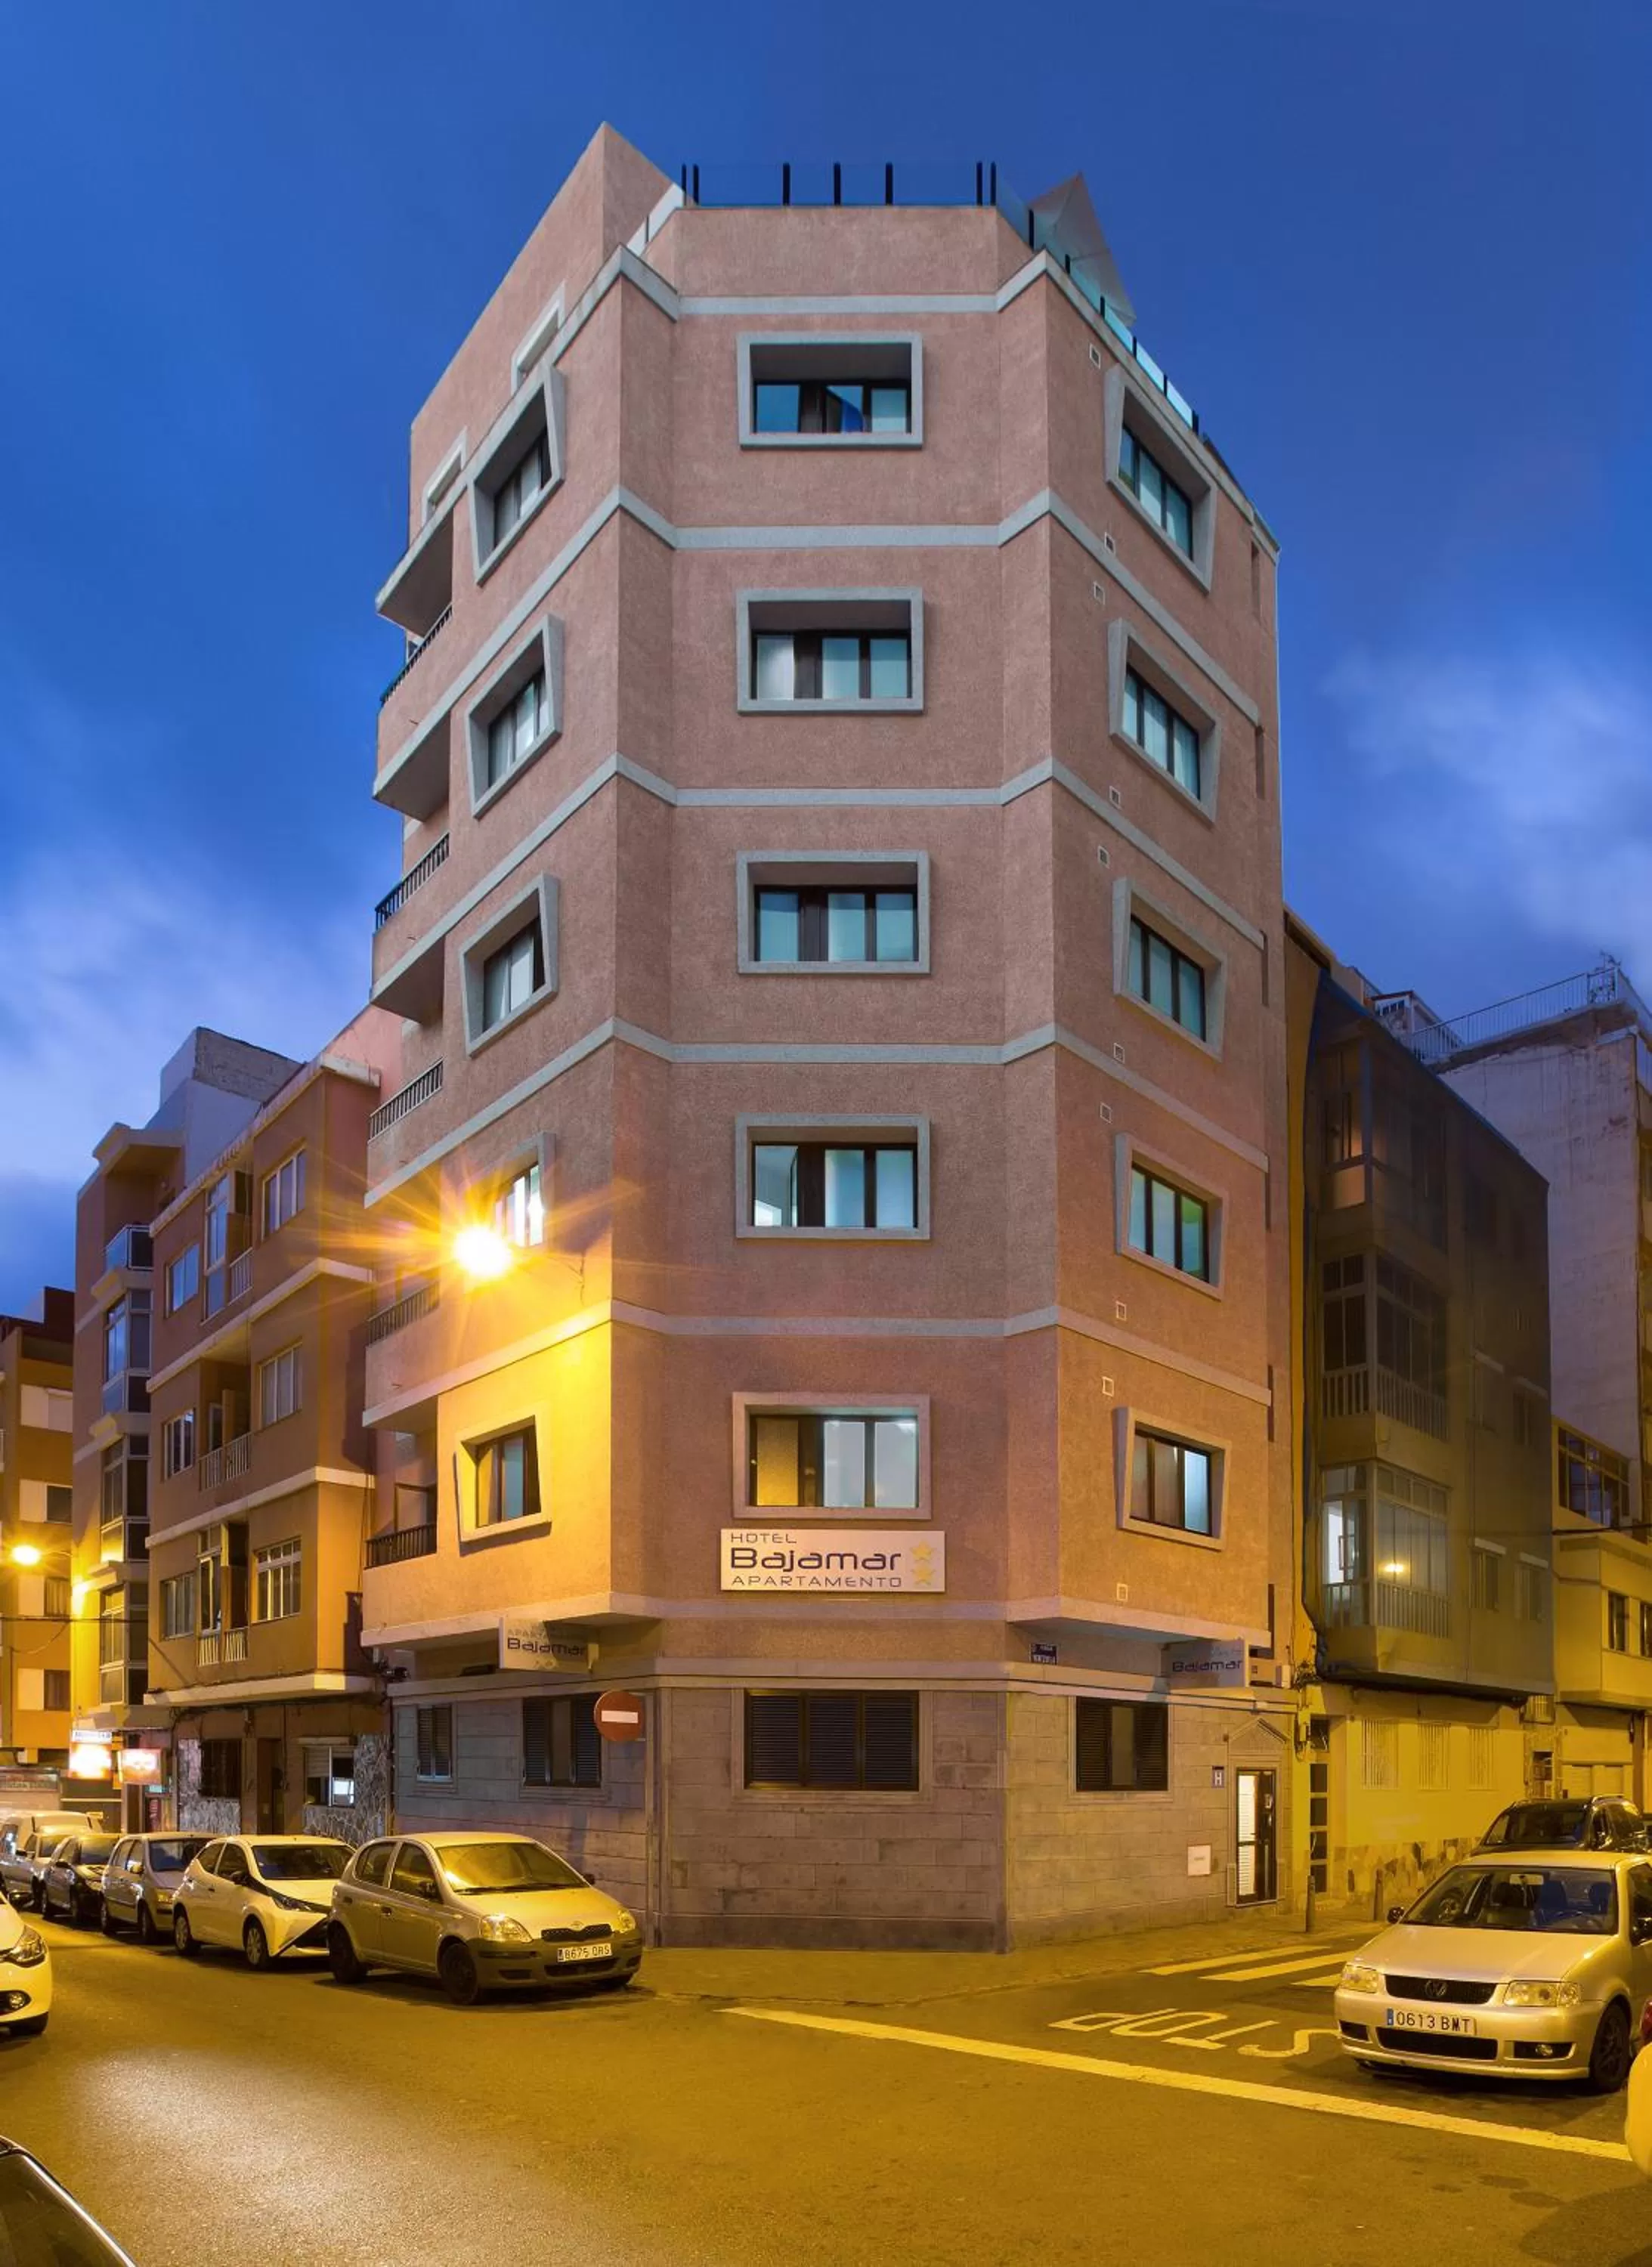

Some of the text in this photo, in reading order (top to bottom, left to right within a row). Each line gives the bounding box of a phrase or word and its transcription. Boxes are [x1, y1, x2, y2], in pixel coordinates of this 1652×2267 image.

[731, 1532, 797, 1544] HOTEL
[731, 1547, 902, 1573] Bajamar
[731, 1576, 902, 1588] APARTAMENTO
[507, 1637, 587, 1656] Bajamar
[1172, 1659, 1243, 1672] Bajamar
[1396, 2011, 1471, 2033] 0613 BMT
[1047, 2008, 1341, 2058] STOP
